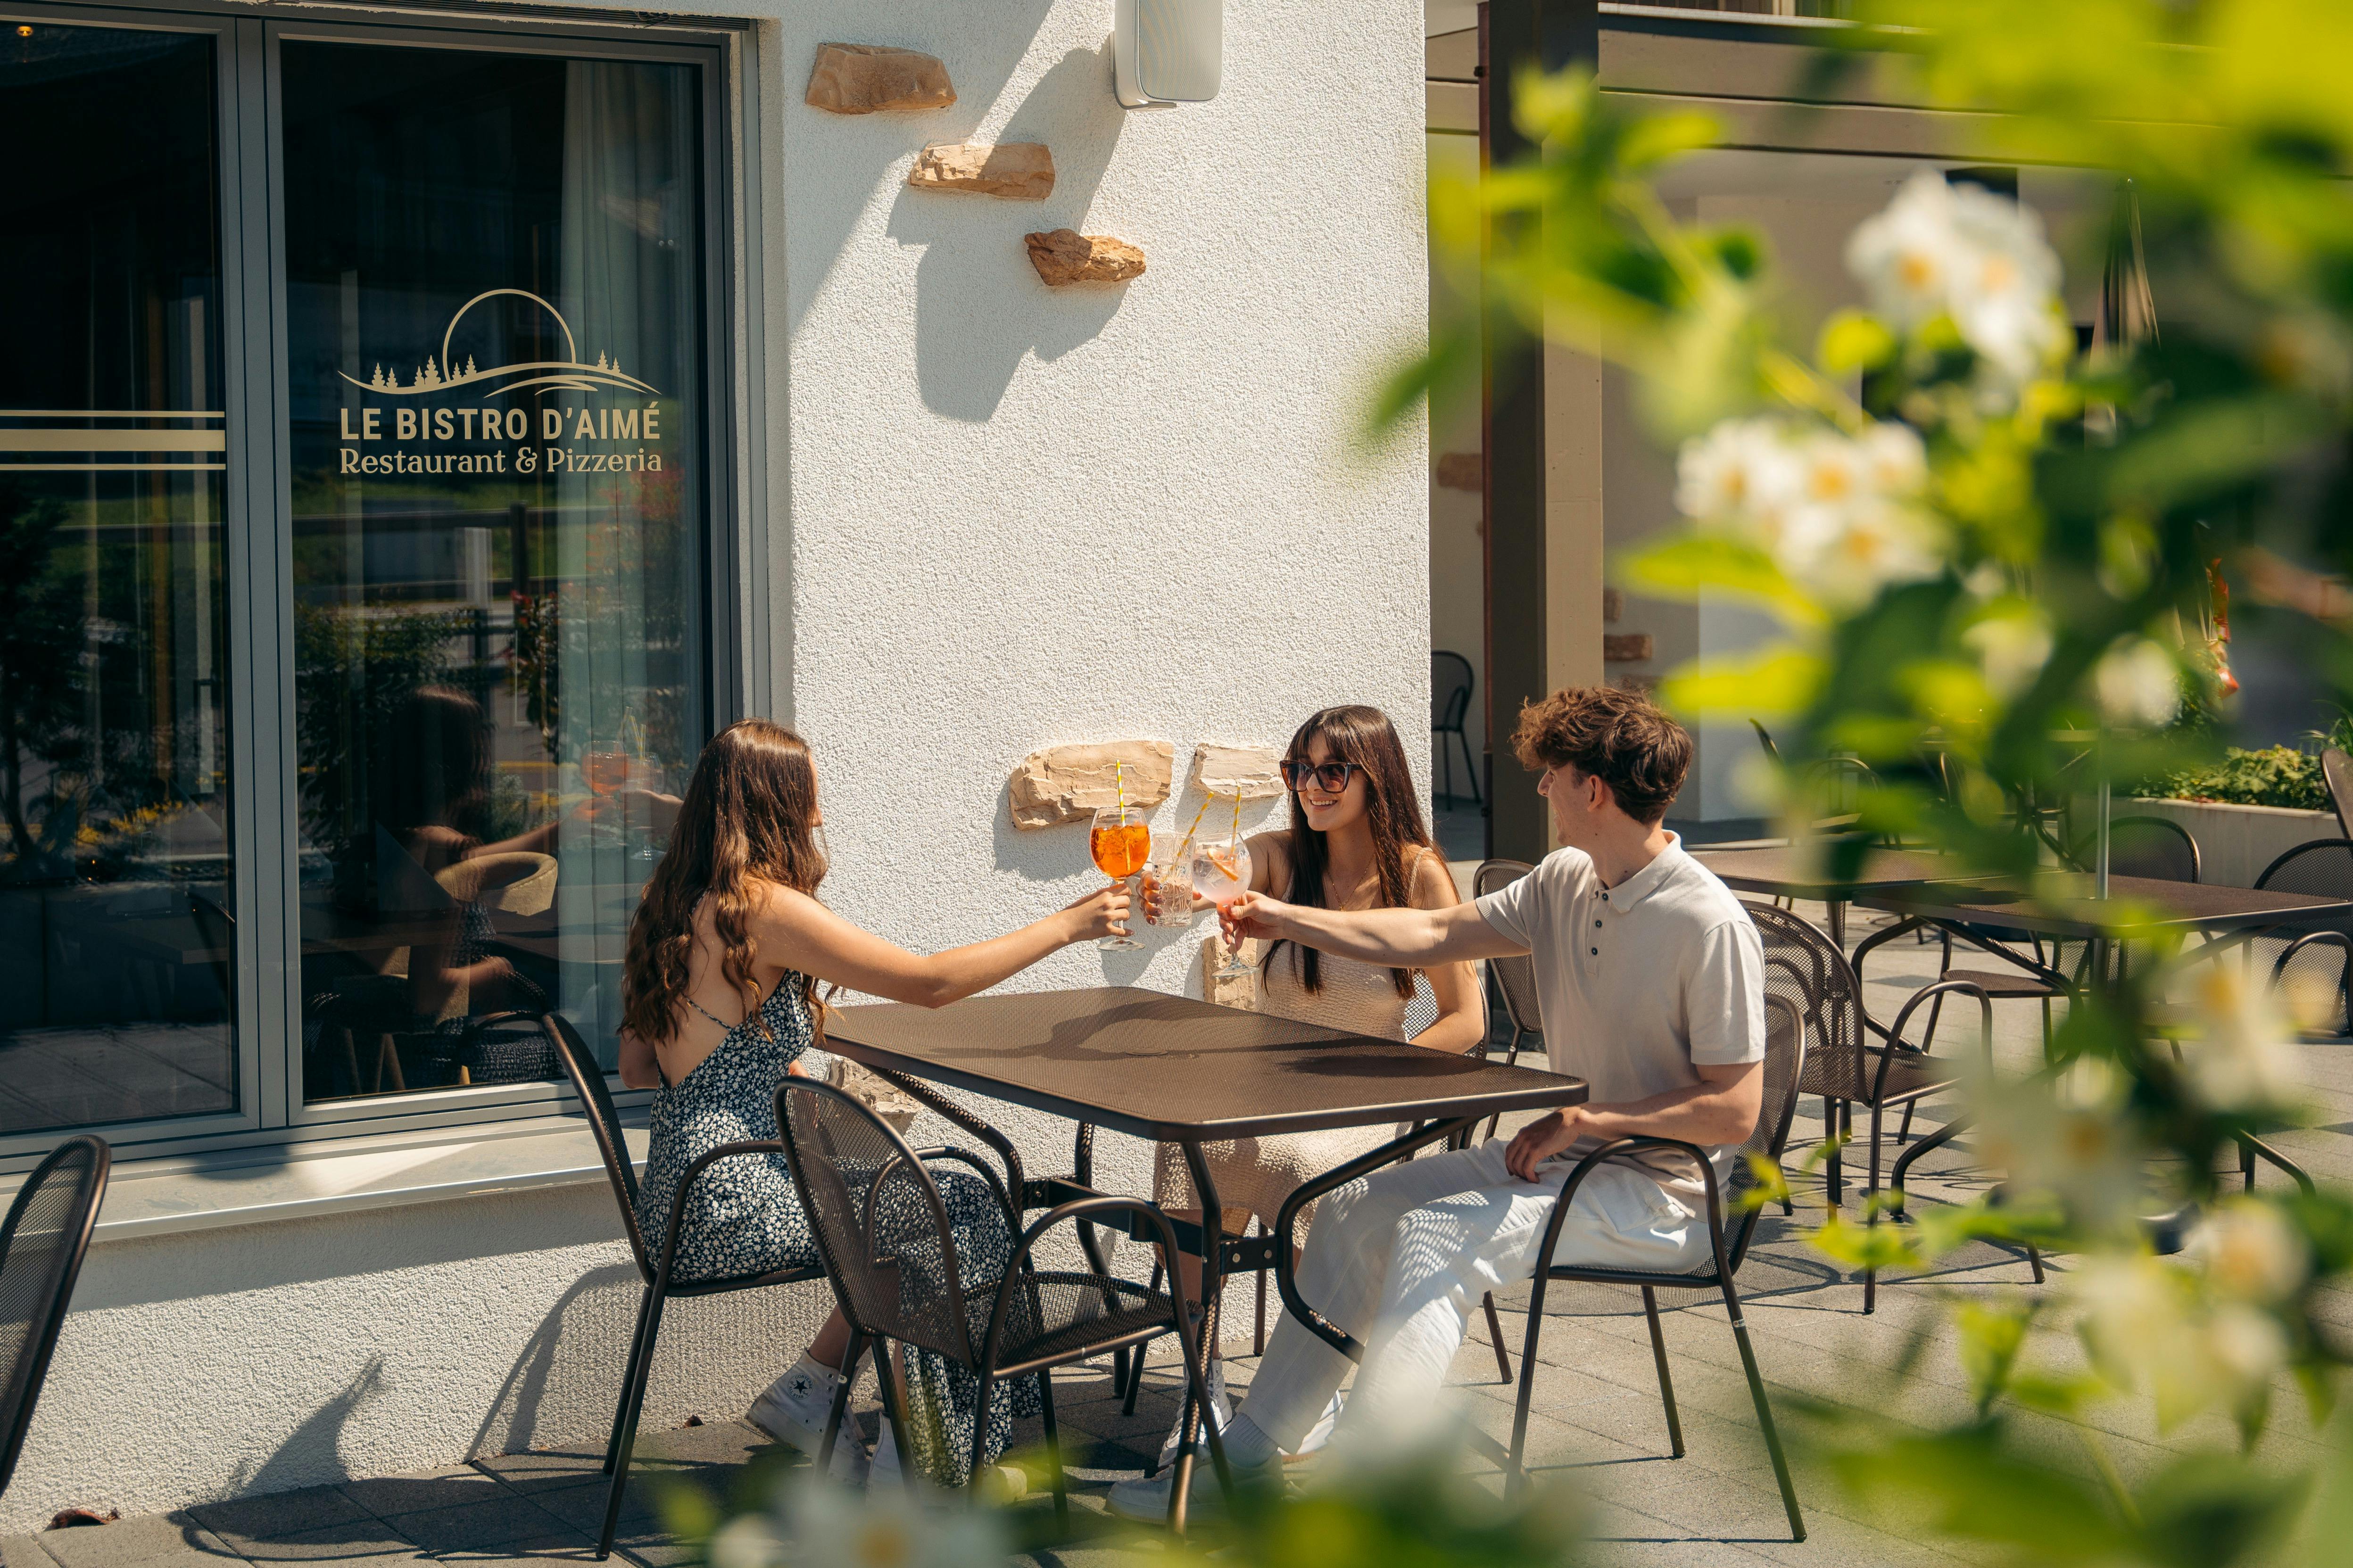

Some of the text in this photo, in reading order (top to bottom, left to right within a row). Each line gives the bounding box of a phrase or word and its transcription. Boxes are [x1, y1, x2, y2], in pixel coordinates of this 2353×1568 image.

[341, 402, 660, 440] LE BISTRO D'AIMÉ
[340, 447, 662, 474] Restaurant & Pizzeria
[795, 1374, 812, 1389] CONVERSE
